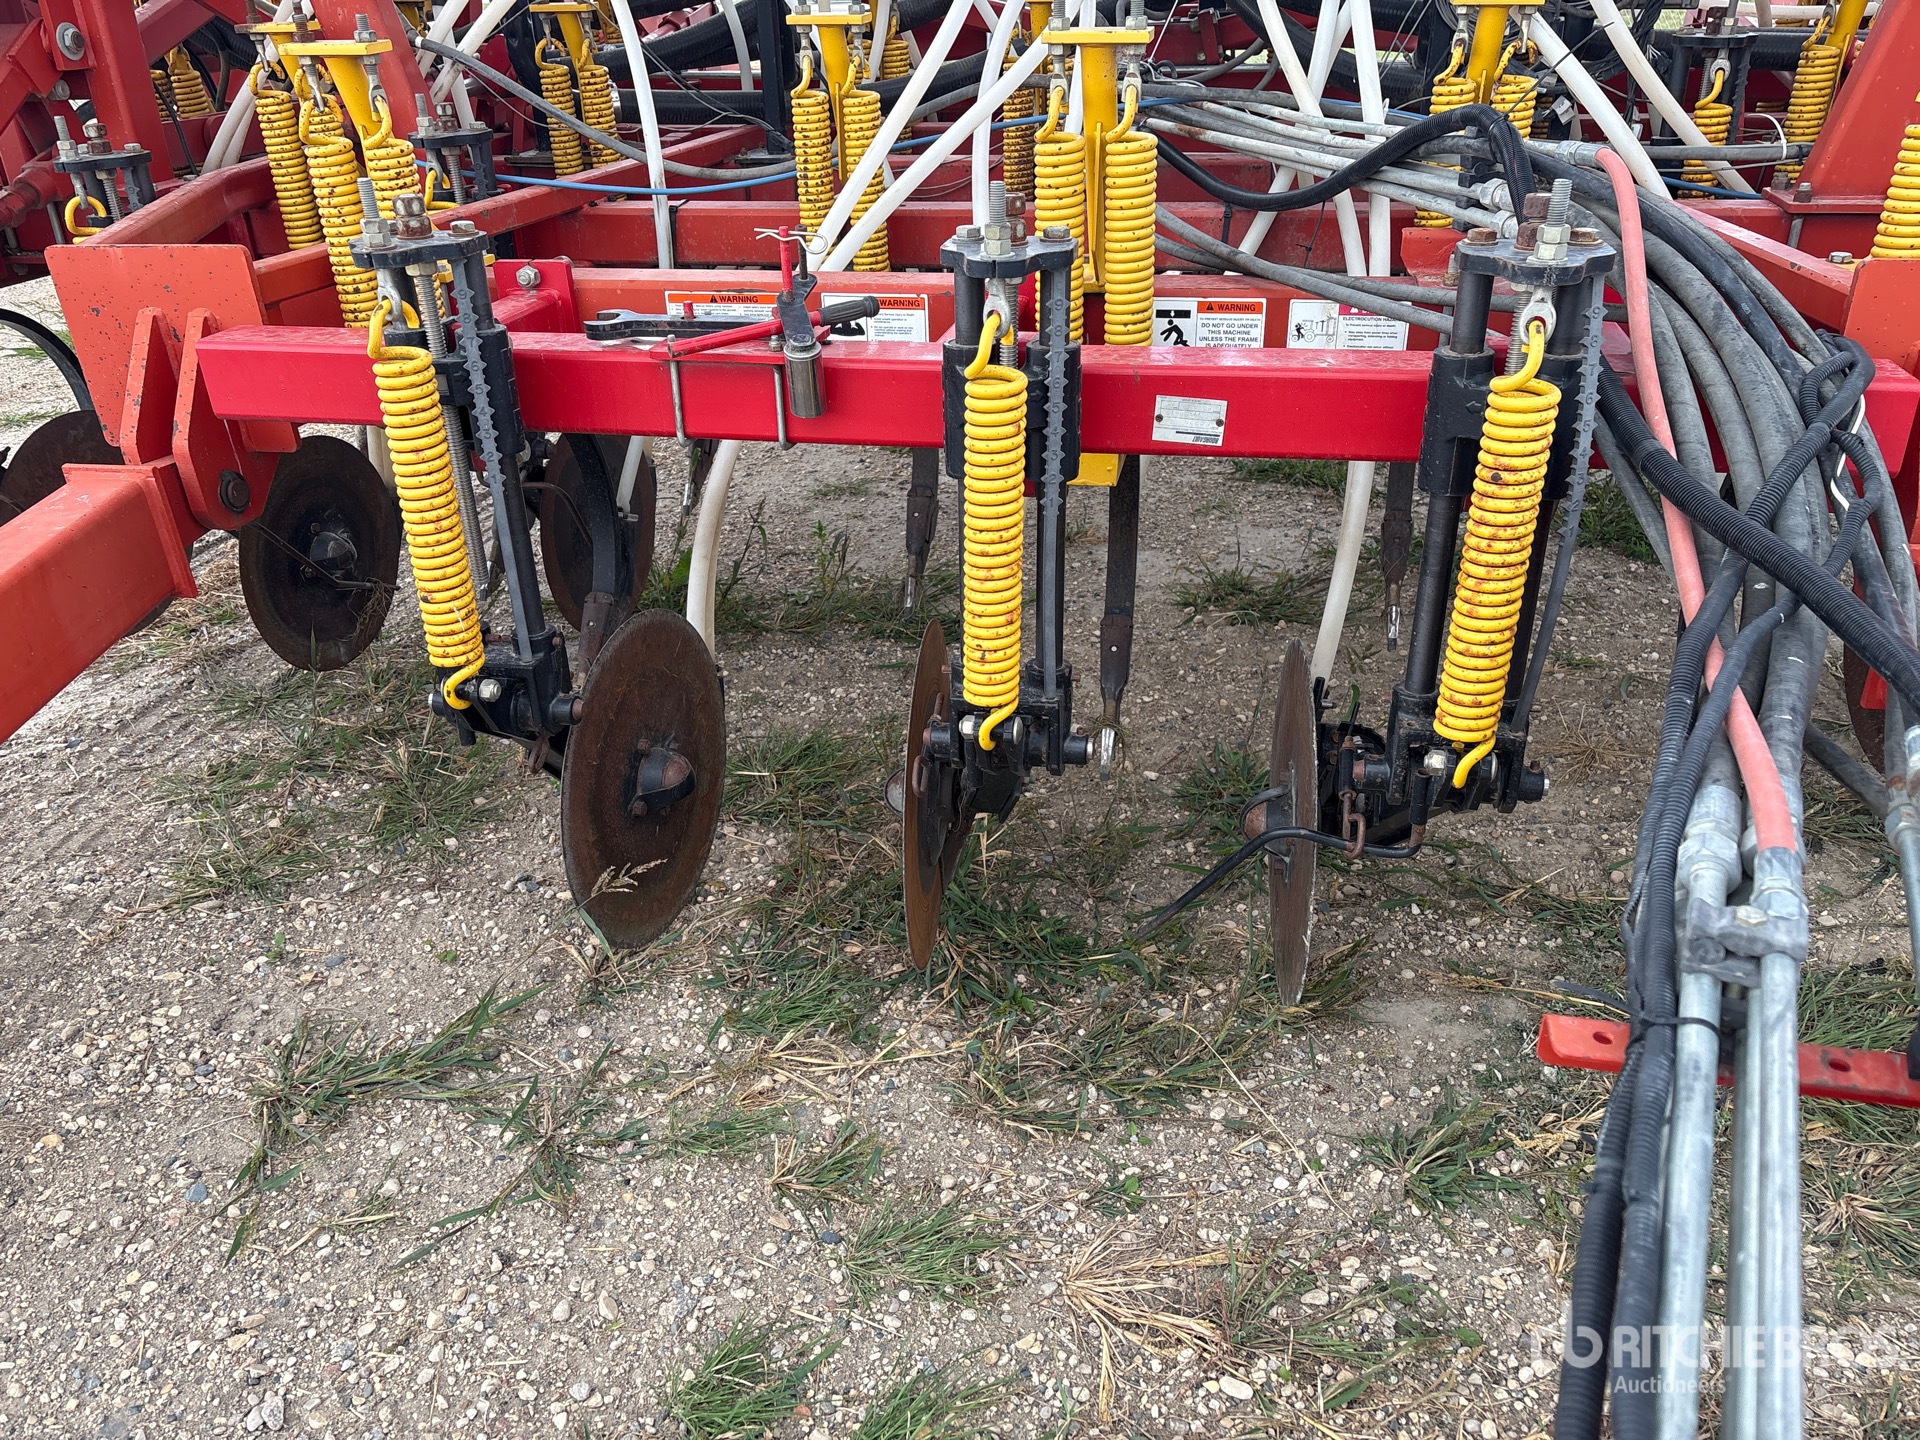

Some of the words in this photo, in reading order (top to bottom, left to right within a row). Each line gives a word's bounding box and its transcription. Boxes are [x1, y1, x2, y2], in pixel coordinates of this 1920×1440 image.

[718, 295, 759, 303] WARNING
[879, 299, 920, 307] WARNING
[1217, 303, 1256, 312] WARNING
